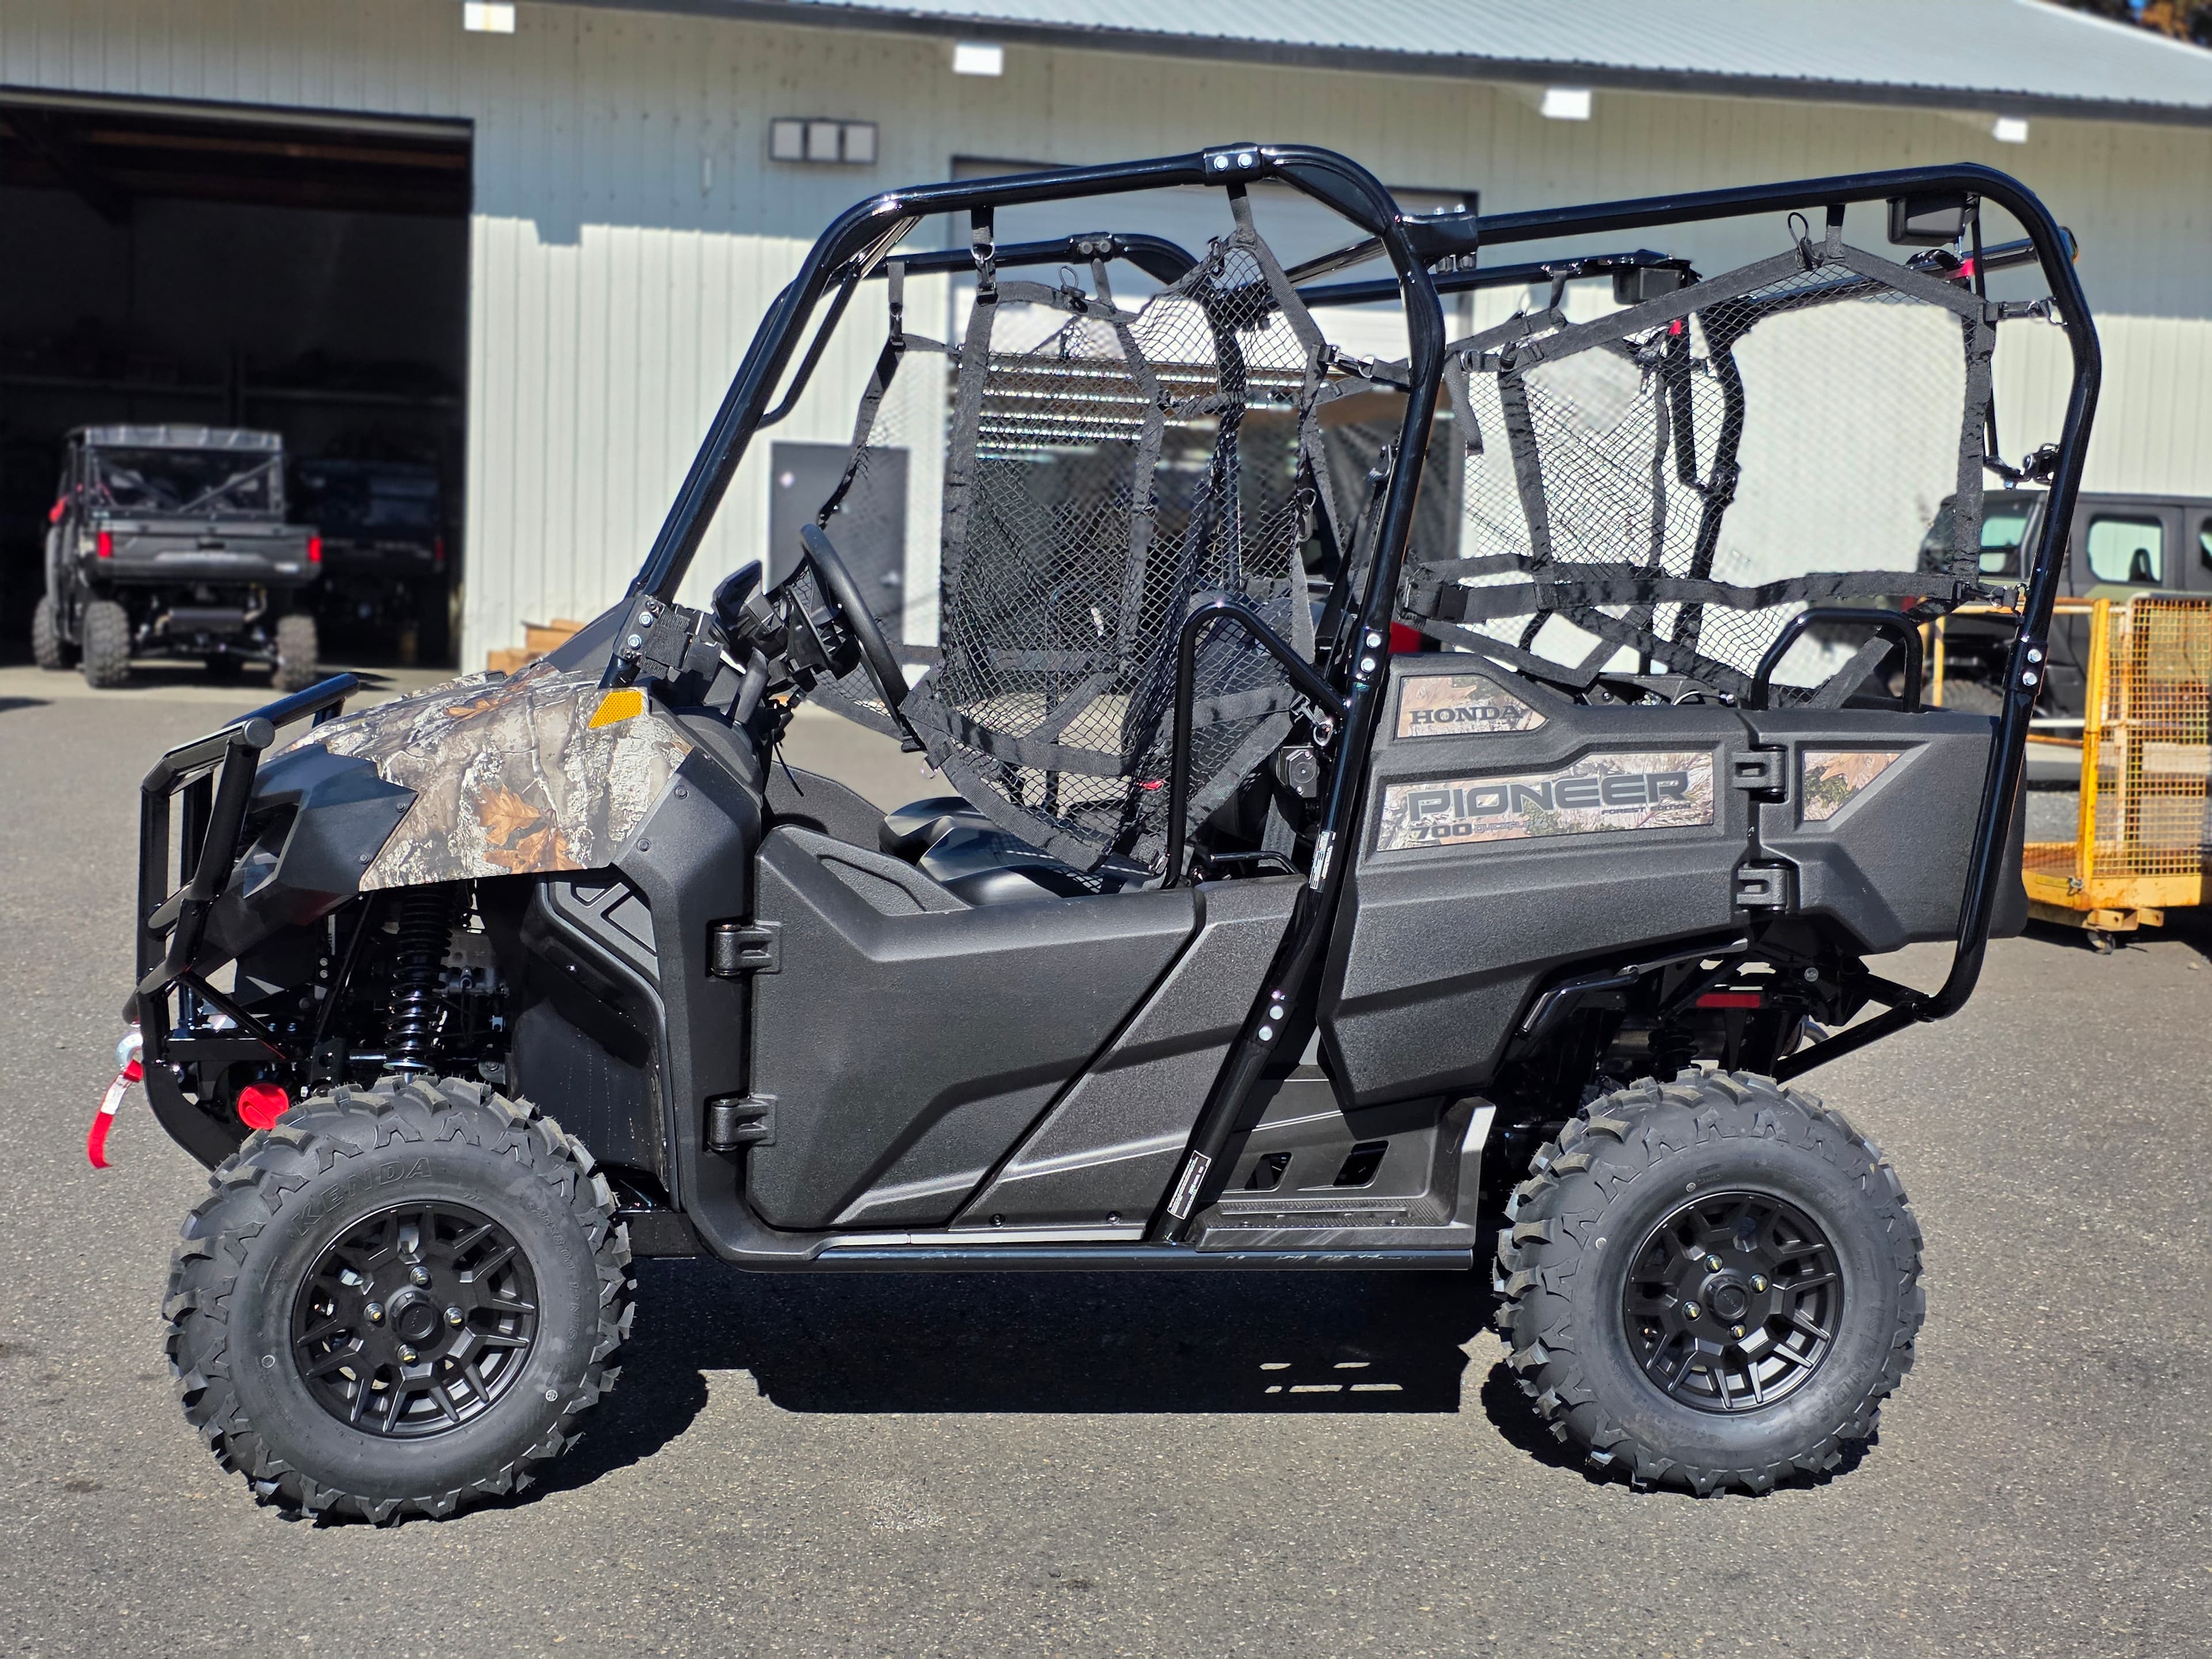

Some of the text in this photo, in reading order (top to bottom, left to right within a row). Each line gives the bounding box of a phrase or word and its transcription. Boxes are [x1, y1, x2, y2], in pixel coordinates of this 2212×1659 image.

[1410, 704, 1524, 725] HONDA
[1406, 771, 1690, 822] PIONEER
[1601, 806, 1646, 815] FOREST
[1410, 823, 1473, 840] 700
[291, 1157, 432, 1237] KENDA
